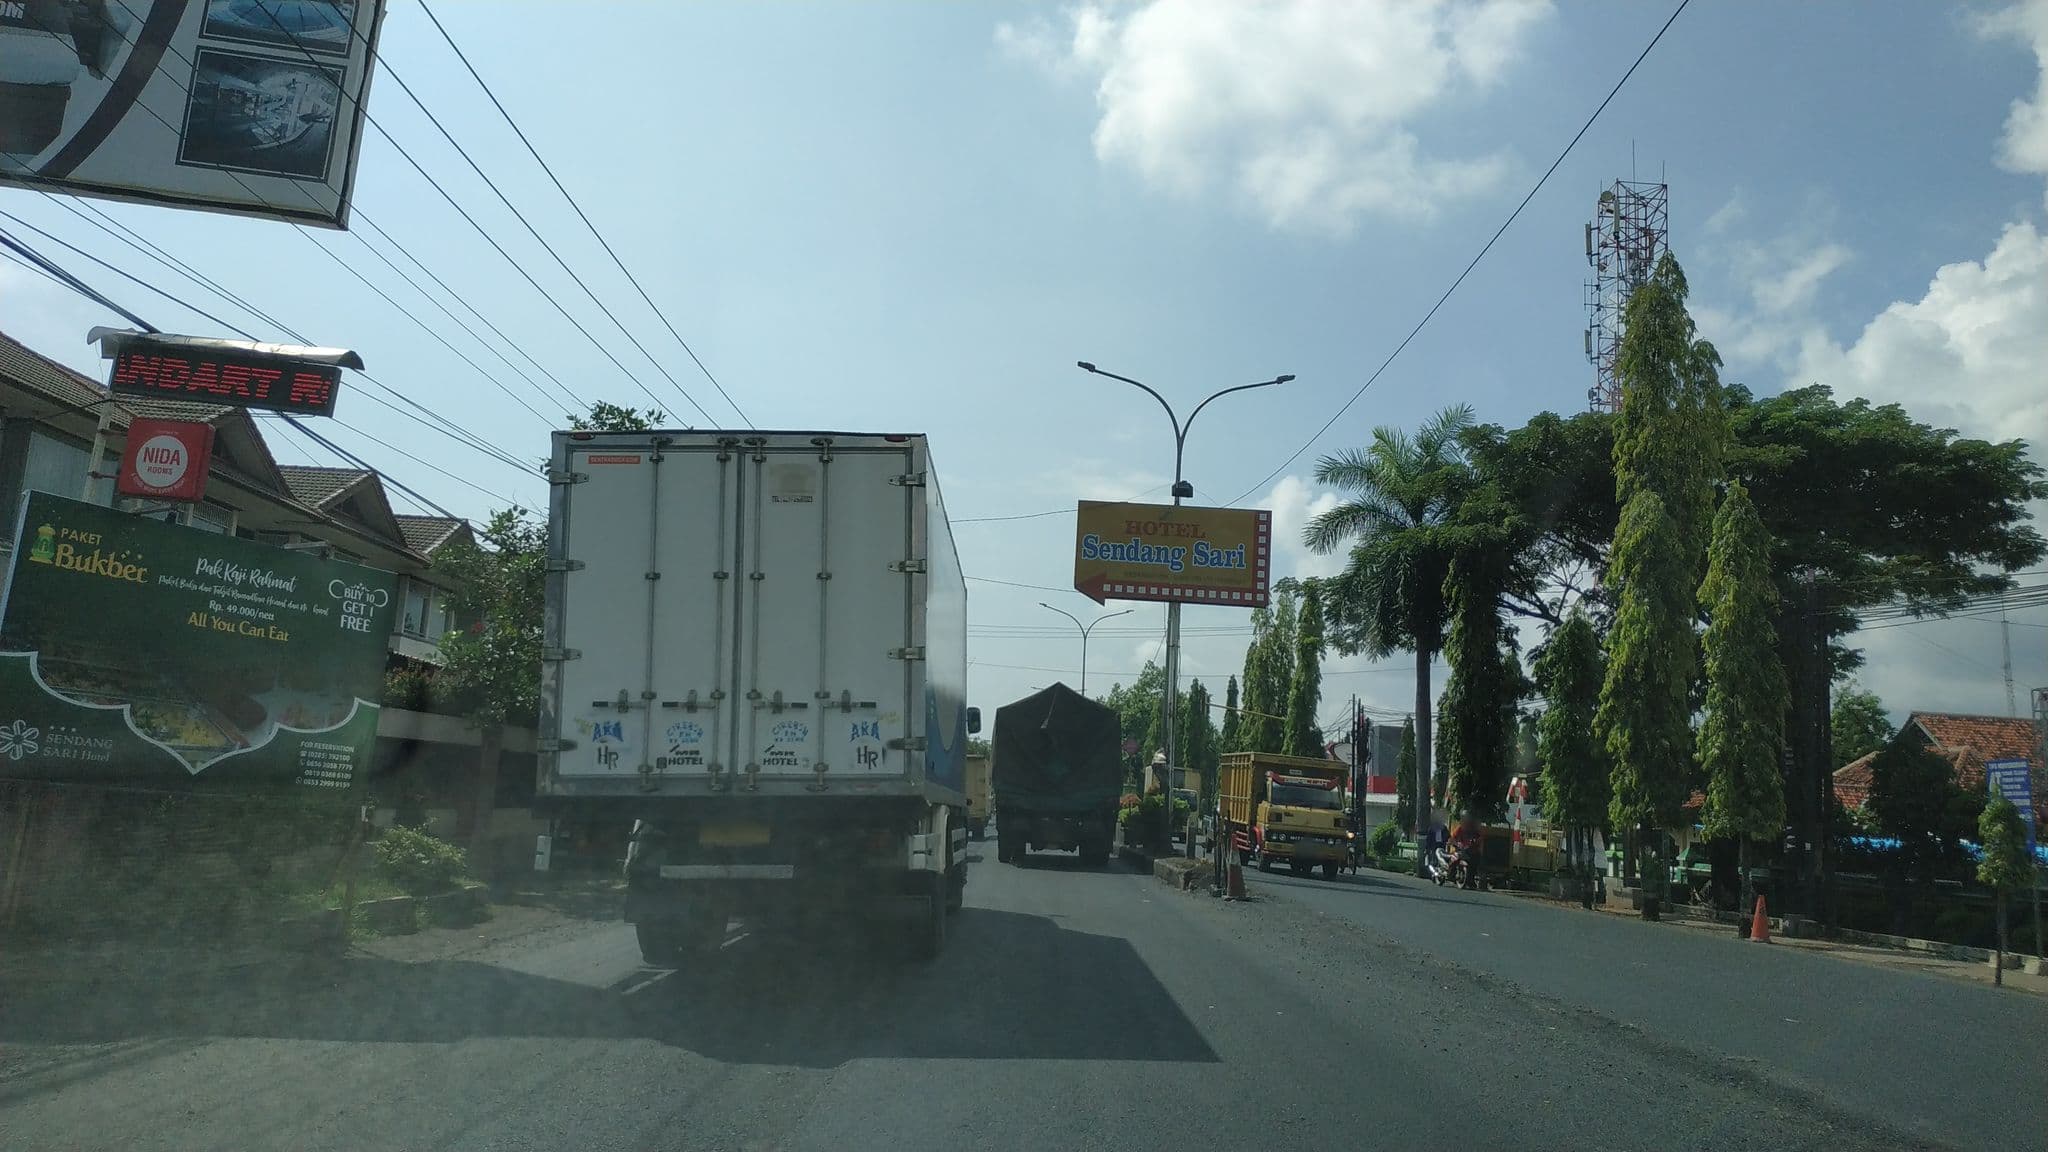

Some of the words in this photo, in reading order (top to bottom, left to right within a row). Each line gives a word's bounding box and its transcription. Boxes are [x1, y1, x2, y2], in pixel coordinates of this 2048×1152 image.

[143, 447, 181, 466] NIDA
[61, 527, 102, 545] PAKET
[1125, 520, 1207, 538] HOTEL
[1082, 534, 1185, 572] Sendang
[1193, 540, 1246, 568] Sari
[55, 543, 148, 583] Bukber
[195, 558, 222, 579] Pak
[223, 563, 247, 585] Kaji
[249, 569, 297, 592] Rahmat
[344, 587, 364, 600] BUY
[366, 593, 376, 603] 10
[209, 600, 224, 612] Rp.
[343, 600, 367, 615] GET
[187, 611, 208, 628] All
[211, 615, 236, 633] You
[239, 620, 265, 638] Can
[268, 624, 290, 641] Eat
[340, 614, 372, 633] FREE
[46, 733, 113, 750] SENDANG
[43, 746, 78, 759] SARI
[668, 756, 704, 766] HOTEL
[763, 757, 799, 766] HOTEL
